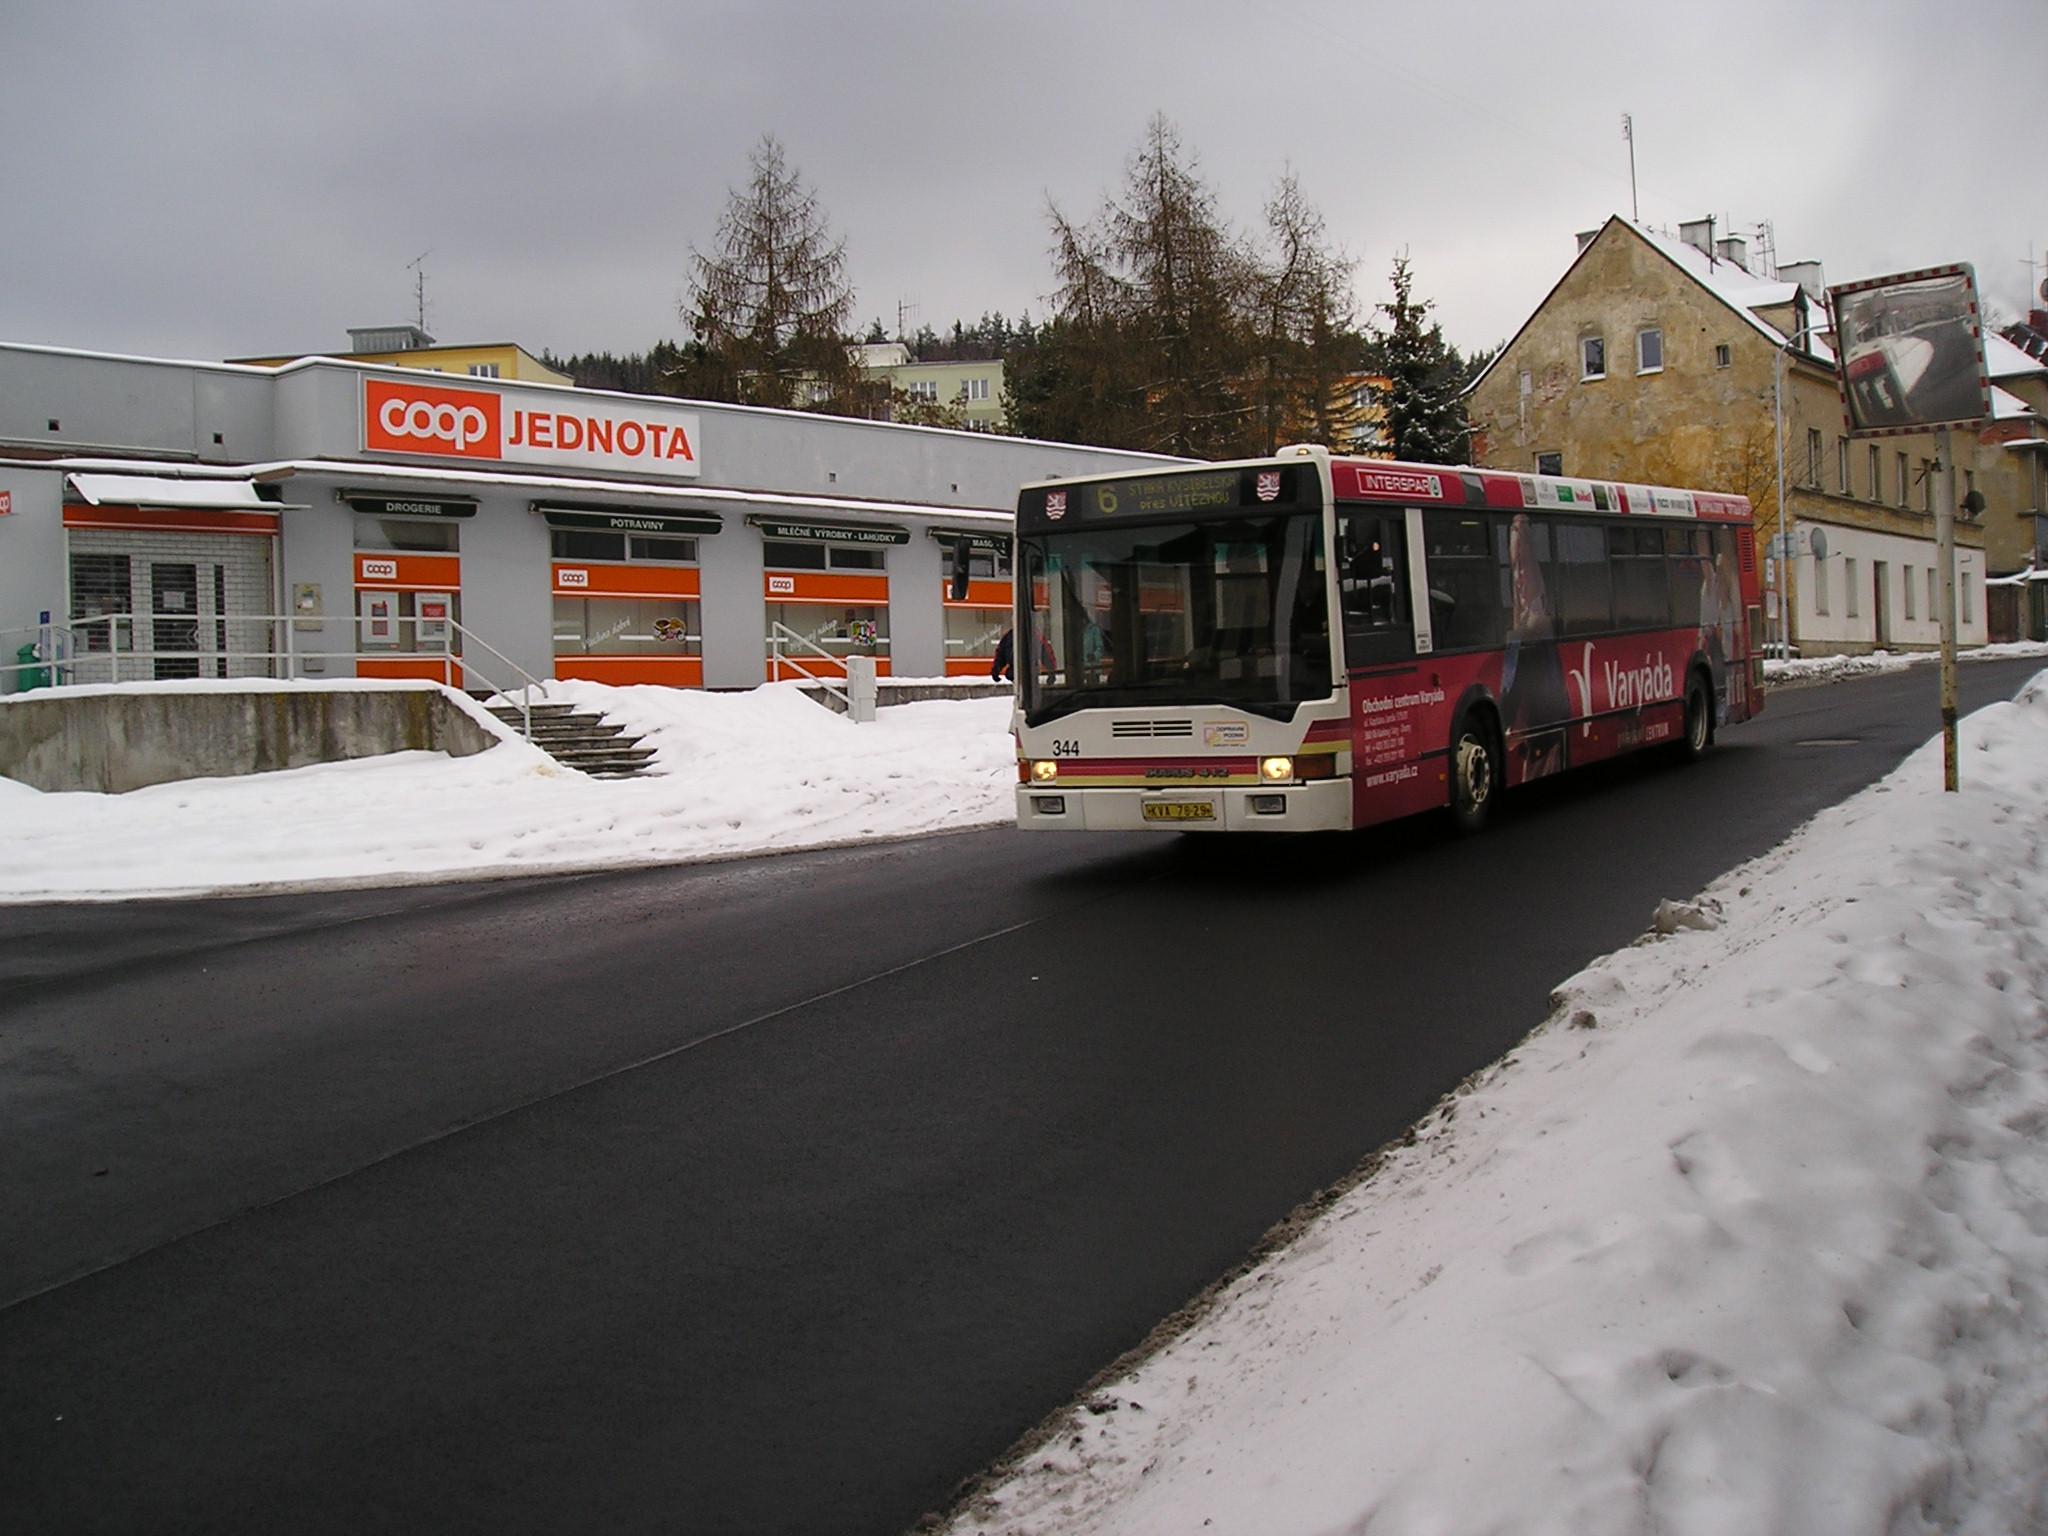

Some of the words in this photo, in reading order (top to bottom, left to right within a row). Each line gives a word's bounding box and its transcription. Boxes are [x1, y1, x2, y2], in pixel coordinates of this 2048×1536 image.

[508, 410, 694, 461] JEDNOTA
[1364, 475, 1431, 492] INTERSPAR
[1096, 484, 1118, 514] 6
[385, 501, 443, 515] DROGERIE
[610, 517, 665, 531] POTRAVINY
[777, 525, 811, 538] MLÉČNÉ
[814, 527, 854, 541] VÝROBKY
[972, 538, 994, 548] MASO
[1603, 650, 1673, 715] Varyáda
[1052, 739, 1080, 757] 344
